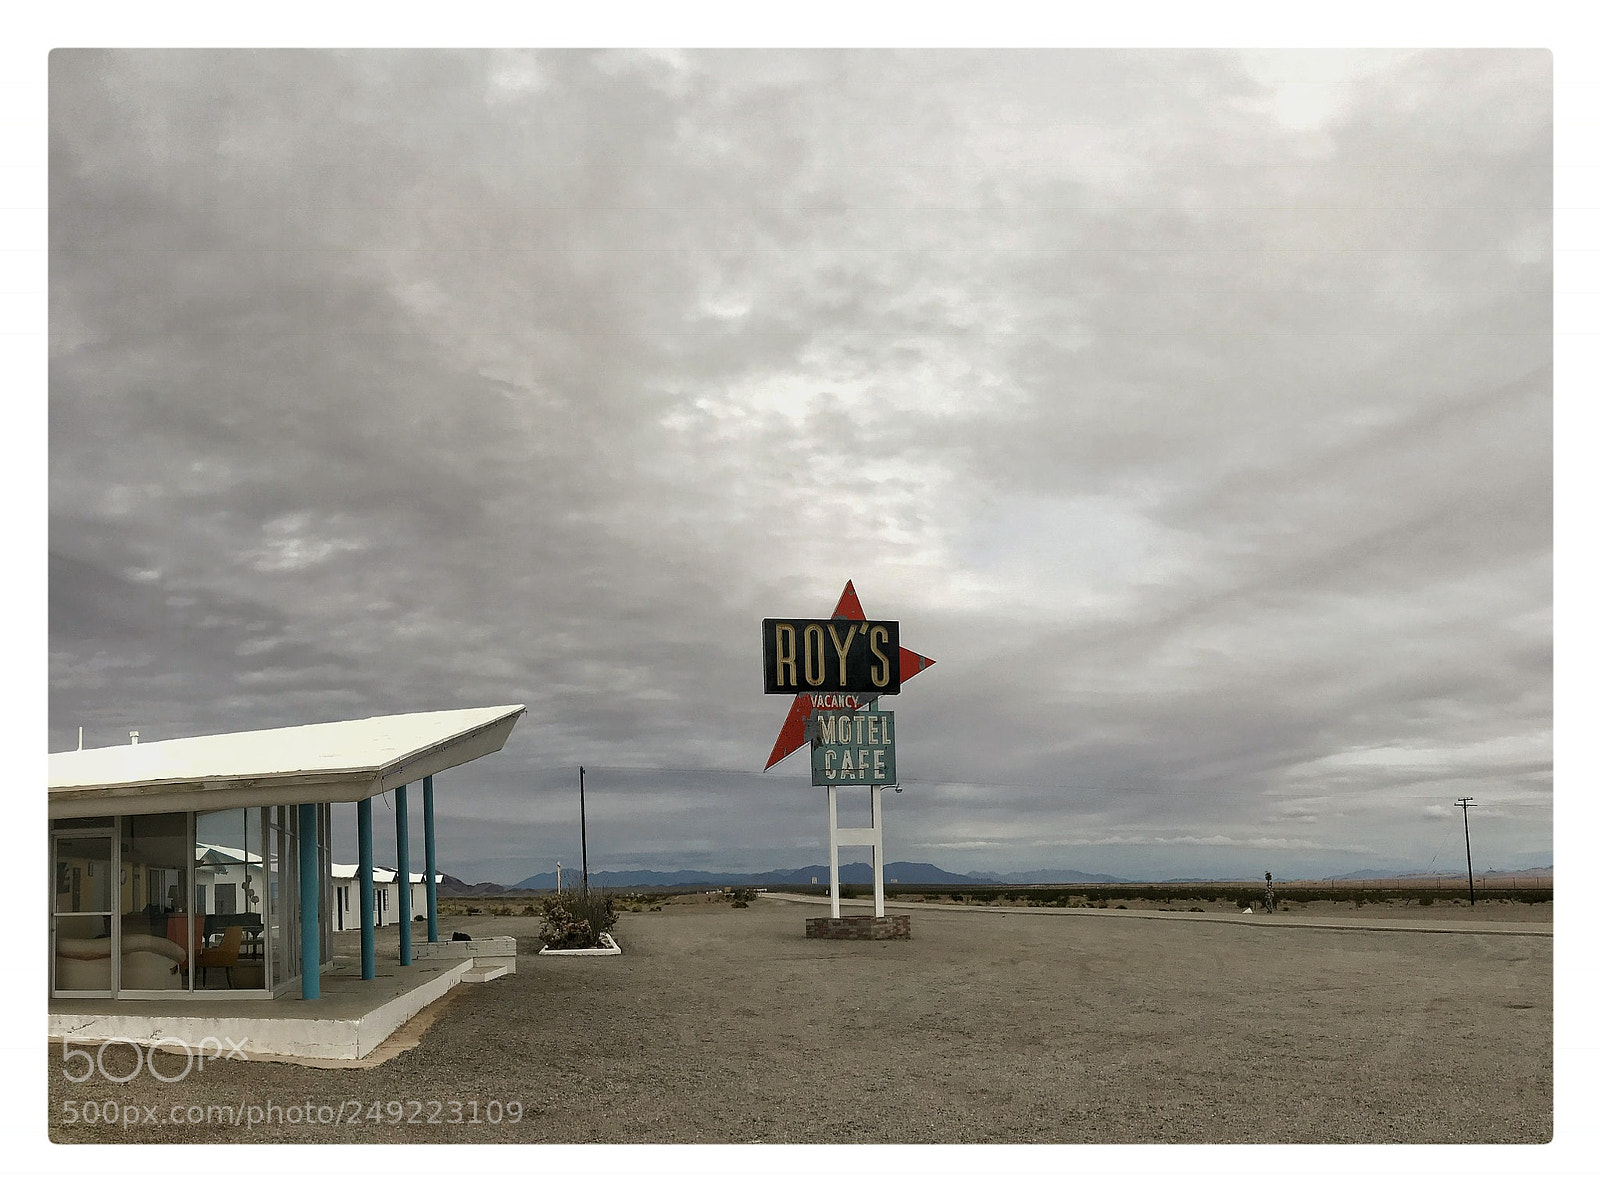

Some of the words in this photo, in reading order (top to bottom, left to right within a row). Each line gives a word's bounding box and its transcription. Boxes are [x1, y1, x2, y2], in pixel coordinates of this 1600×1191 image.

[775, 622, 891, 688] ROY'S
[810, 694, 860, 708] VACANCY
[817, 715, 892, 746] MOTEL
[824, 749, 886, 780] CAFE
